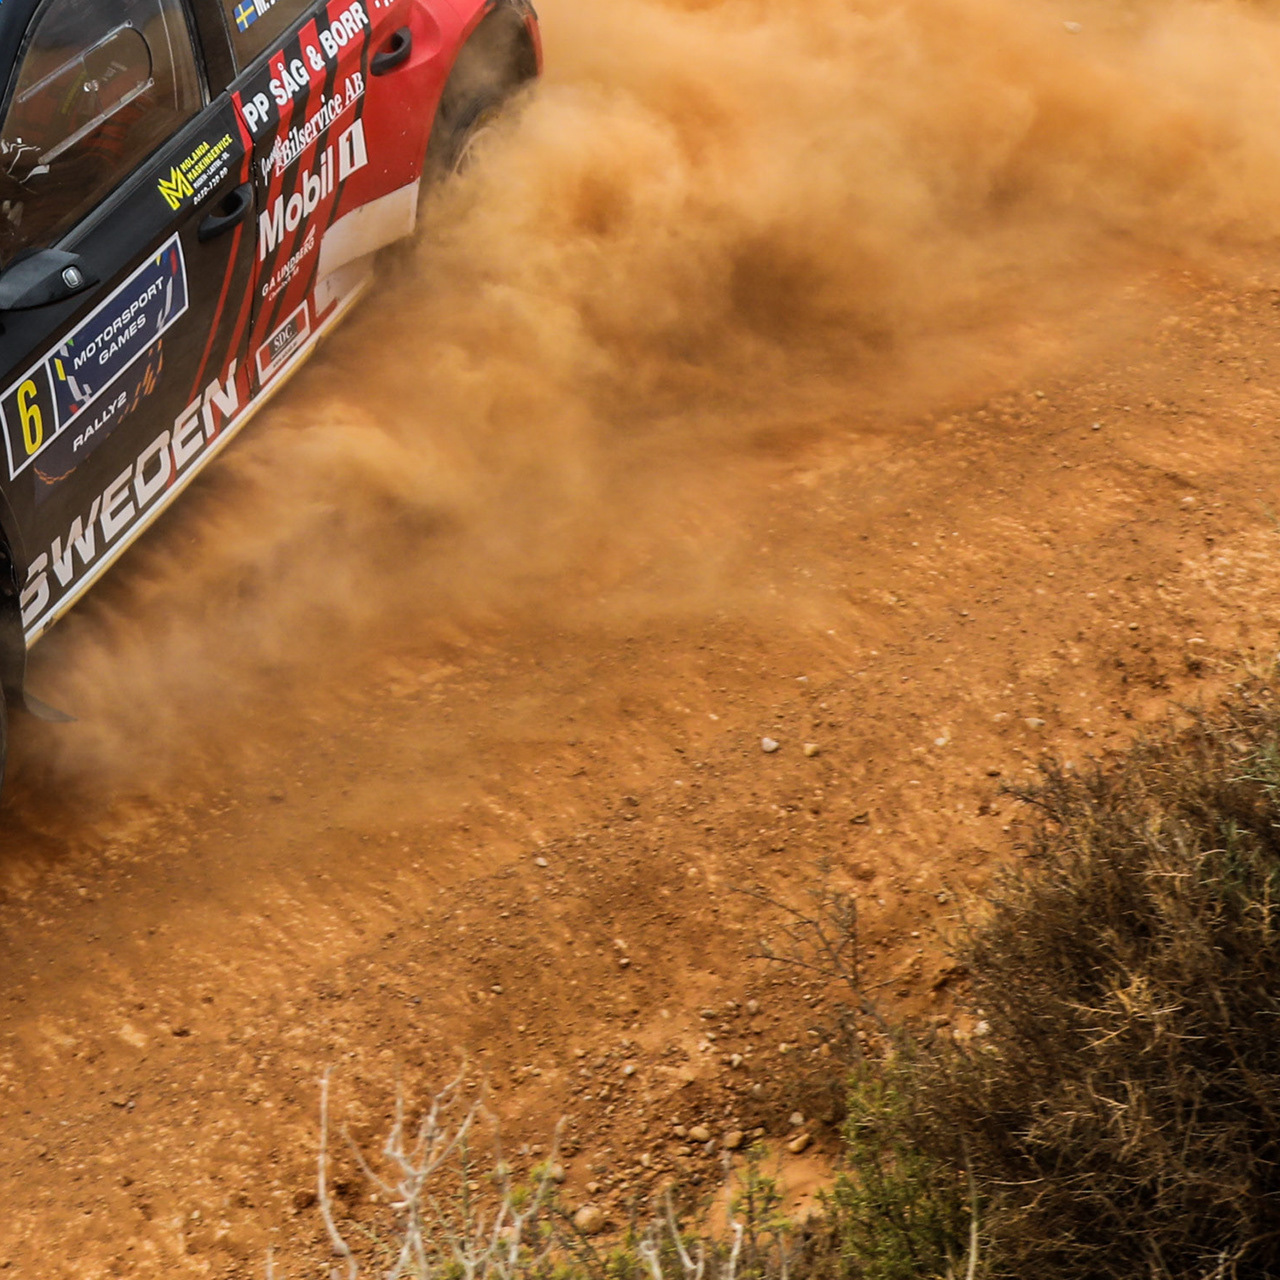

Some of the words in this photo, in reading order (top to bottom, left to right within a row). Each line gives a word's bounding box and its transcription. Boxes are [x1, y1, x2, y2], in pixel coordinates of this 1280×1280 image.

[241, 92, 270, 134] PP
[268, 58, 311, 107] SÅG
[305, 44, 327, 72] &
[318, 1, 370, 59] BORR
[281, 94, 344, 166] Bilservice
[344, 71, 365, 106] AB
[259, 144, 334, 262] Mobil
[276, 236, 315, 283] LINDBERG
[73, 275, 165, 370] MOTORSPORT
[98, 313, 147, 366] GAMES
[273, 324, 293, 352] SDC
[16, 378, 44, 456] 6
[72, 391, 128, 453] RALLY2
[20, 357, 239, 628] SWEDEN
